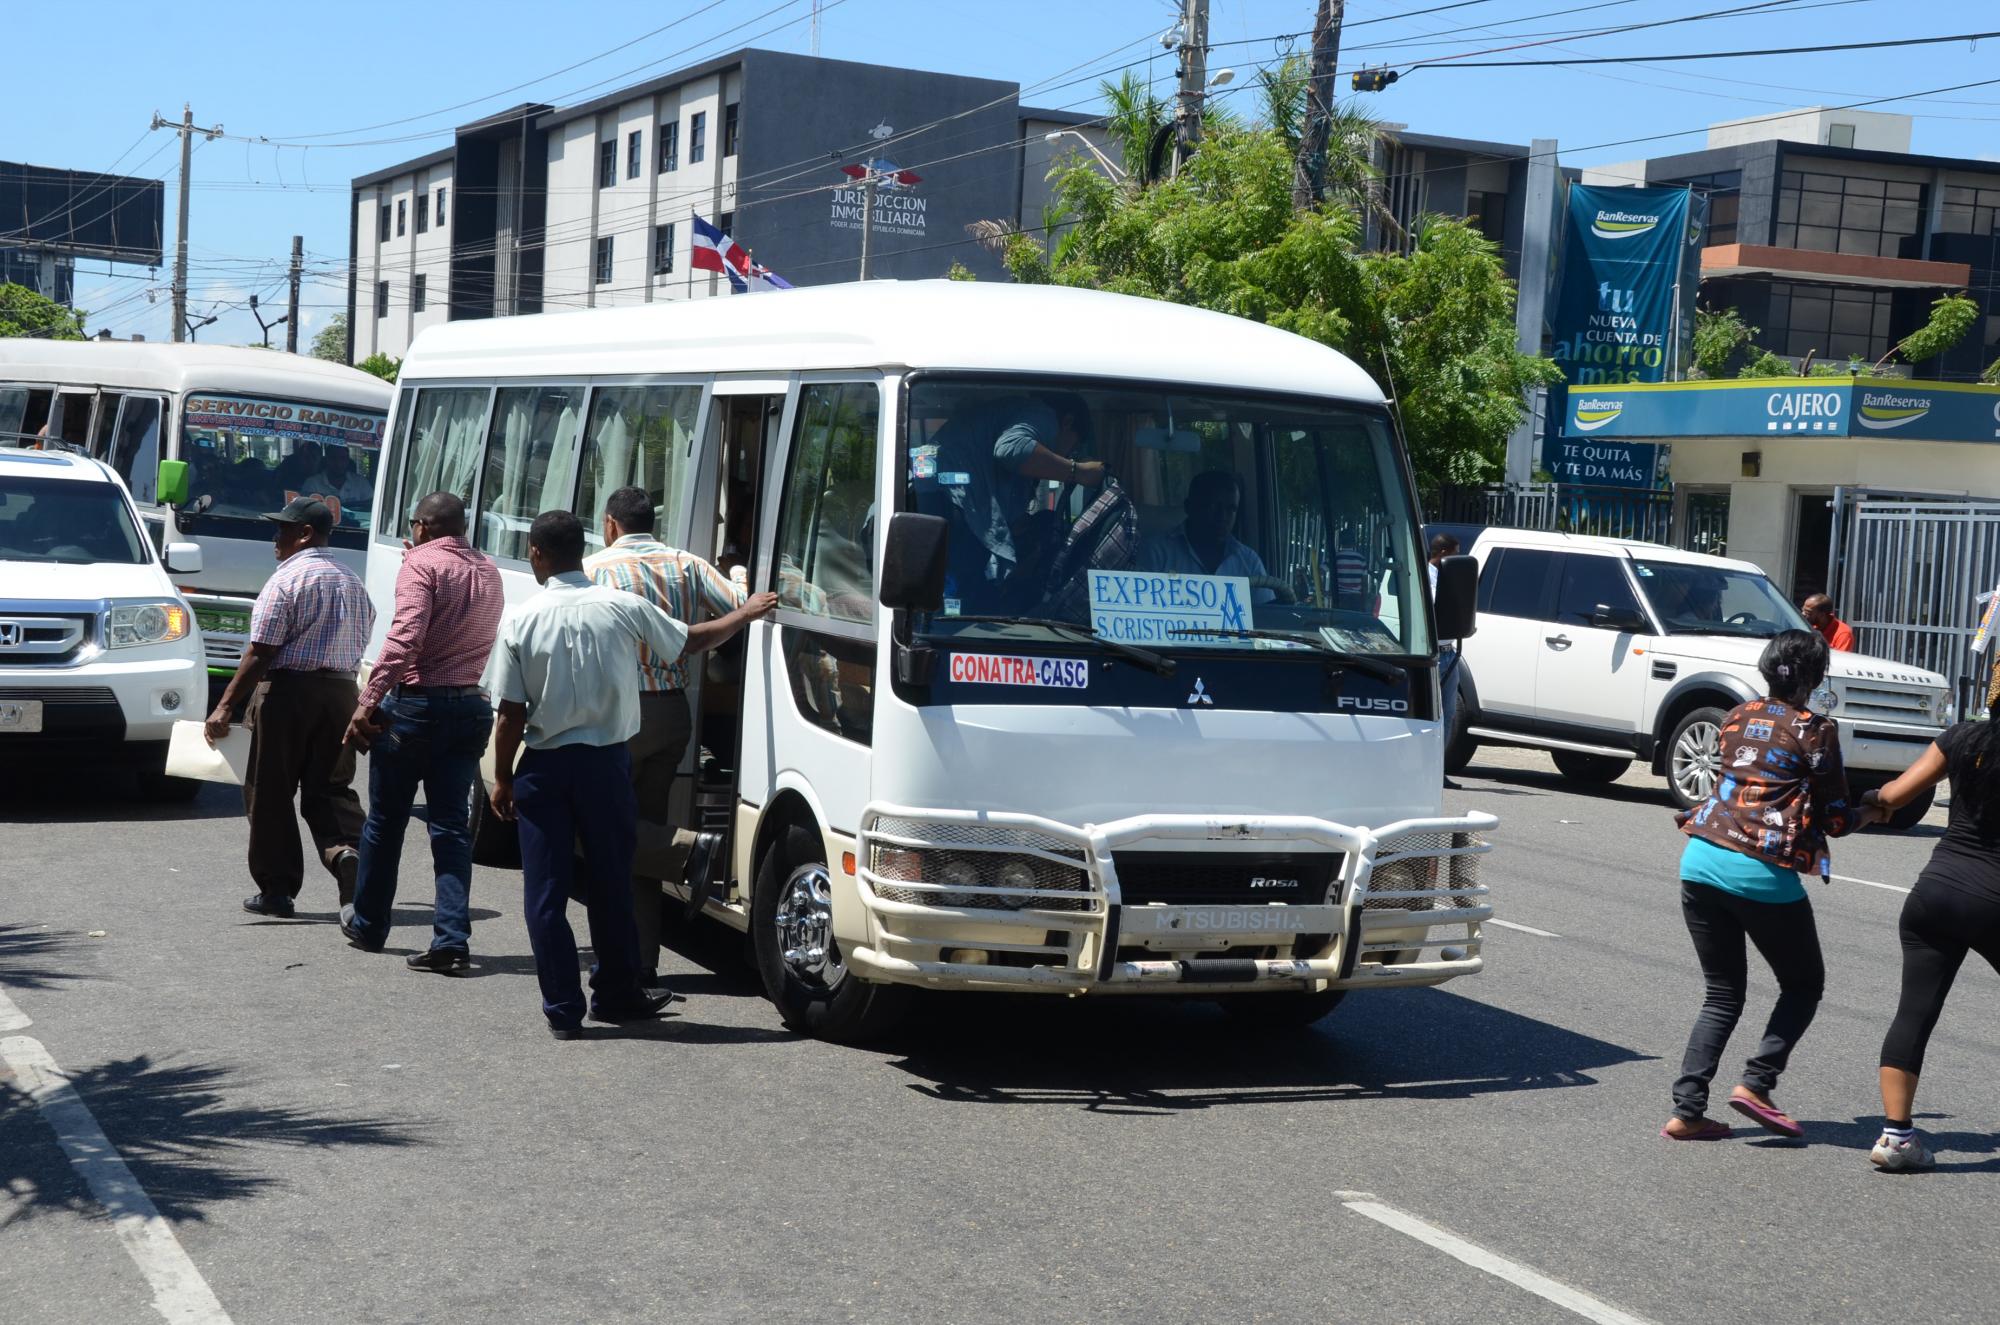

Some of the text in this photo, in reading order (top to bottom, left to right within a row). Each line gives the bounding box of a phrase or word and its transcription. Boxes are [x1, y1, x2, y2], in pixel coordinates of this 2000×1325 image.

[831, 204, 926, 228] INMOILIARIA
[1597, 210, 1659, 223] BanReservas
[1598, 281, 1634, 313] tu
[1589, 314, 1637, 329] NUEVA
[1586, 330, 1662, 346] CUENTA DE
[1553, 332, 1662, 368] ahorro
[1578, 399, 1624, 411] BanReservas
[1767, 393, 1841, 420] CAJERO
[1862, 393, 1931, 409] BanReservas
[186, 399, 374, 432] SERVICIO RAPIDO
[240, 427, 277, 437] AHORA
[1563, 444, 1631, 463] TE QUITA
[1552, 461, 1643, 481] Y TE DA MÁS
[1095, 576, 1217, 609] EXPRESO
[952, 655, 1086, 687] CONATRA-CASC
[1846, 669, 1932, 684] LAND ROVER
[1337, 695, 1409, 712] FUSO
[1156, 911, 1289, 929] MTSUBISHI
